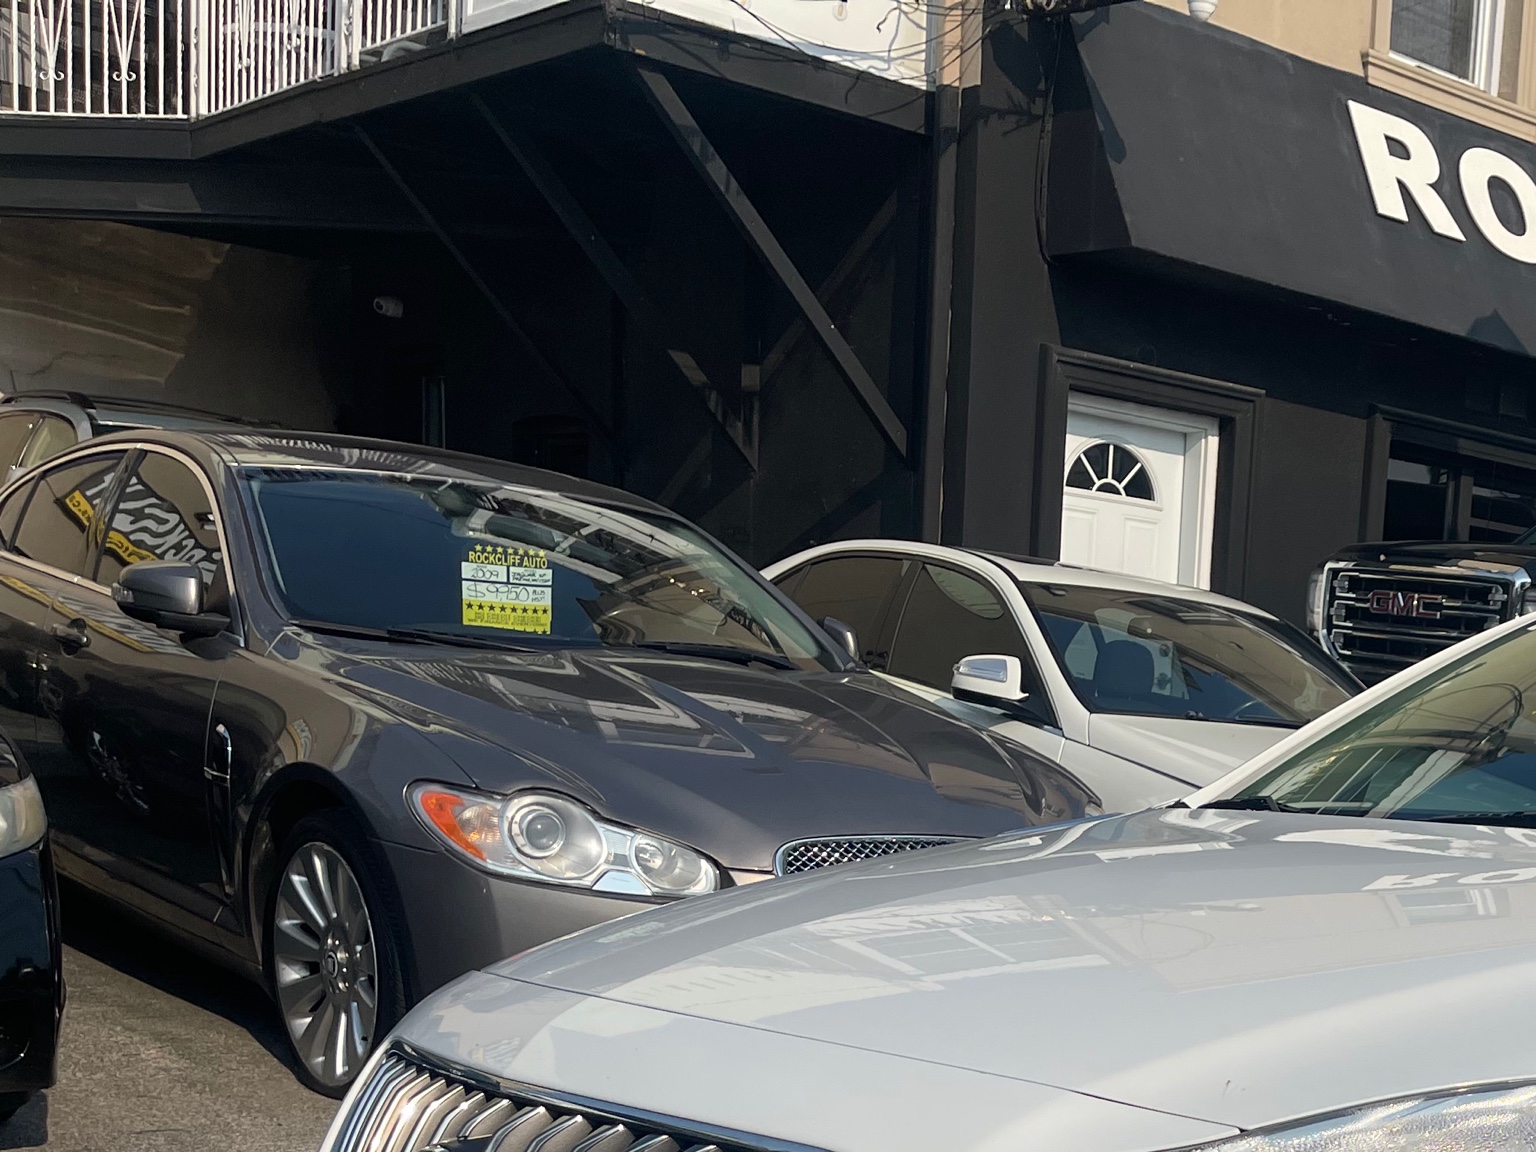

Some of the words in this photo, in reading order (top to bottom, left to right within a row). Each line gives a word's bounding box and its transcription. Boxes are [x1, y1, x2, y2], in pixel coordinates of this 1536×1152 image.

[469, 551, 520, 567] ROCKCLIFF
[522, 556, 548, 569] AUTO
[471, 567, 499, 580] 2009
[1369, 589, 1442, 619] GMC
